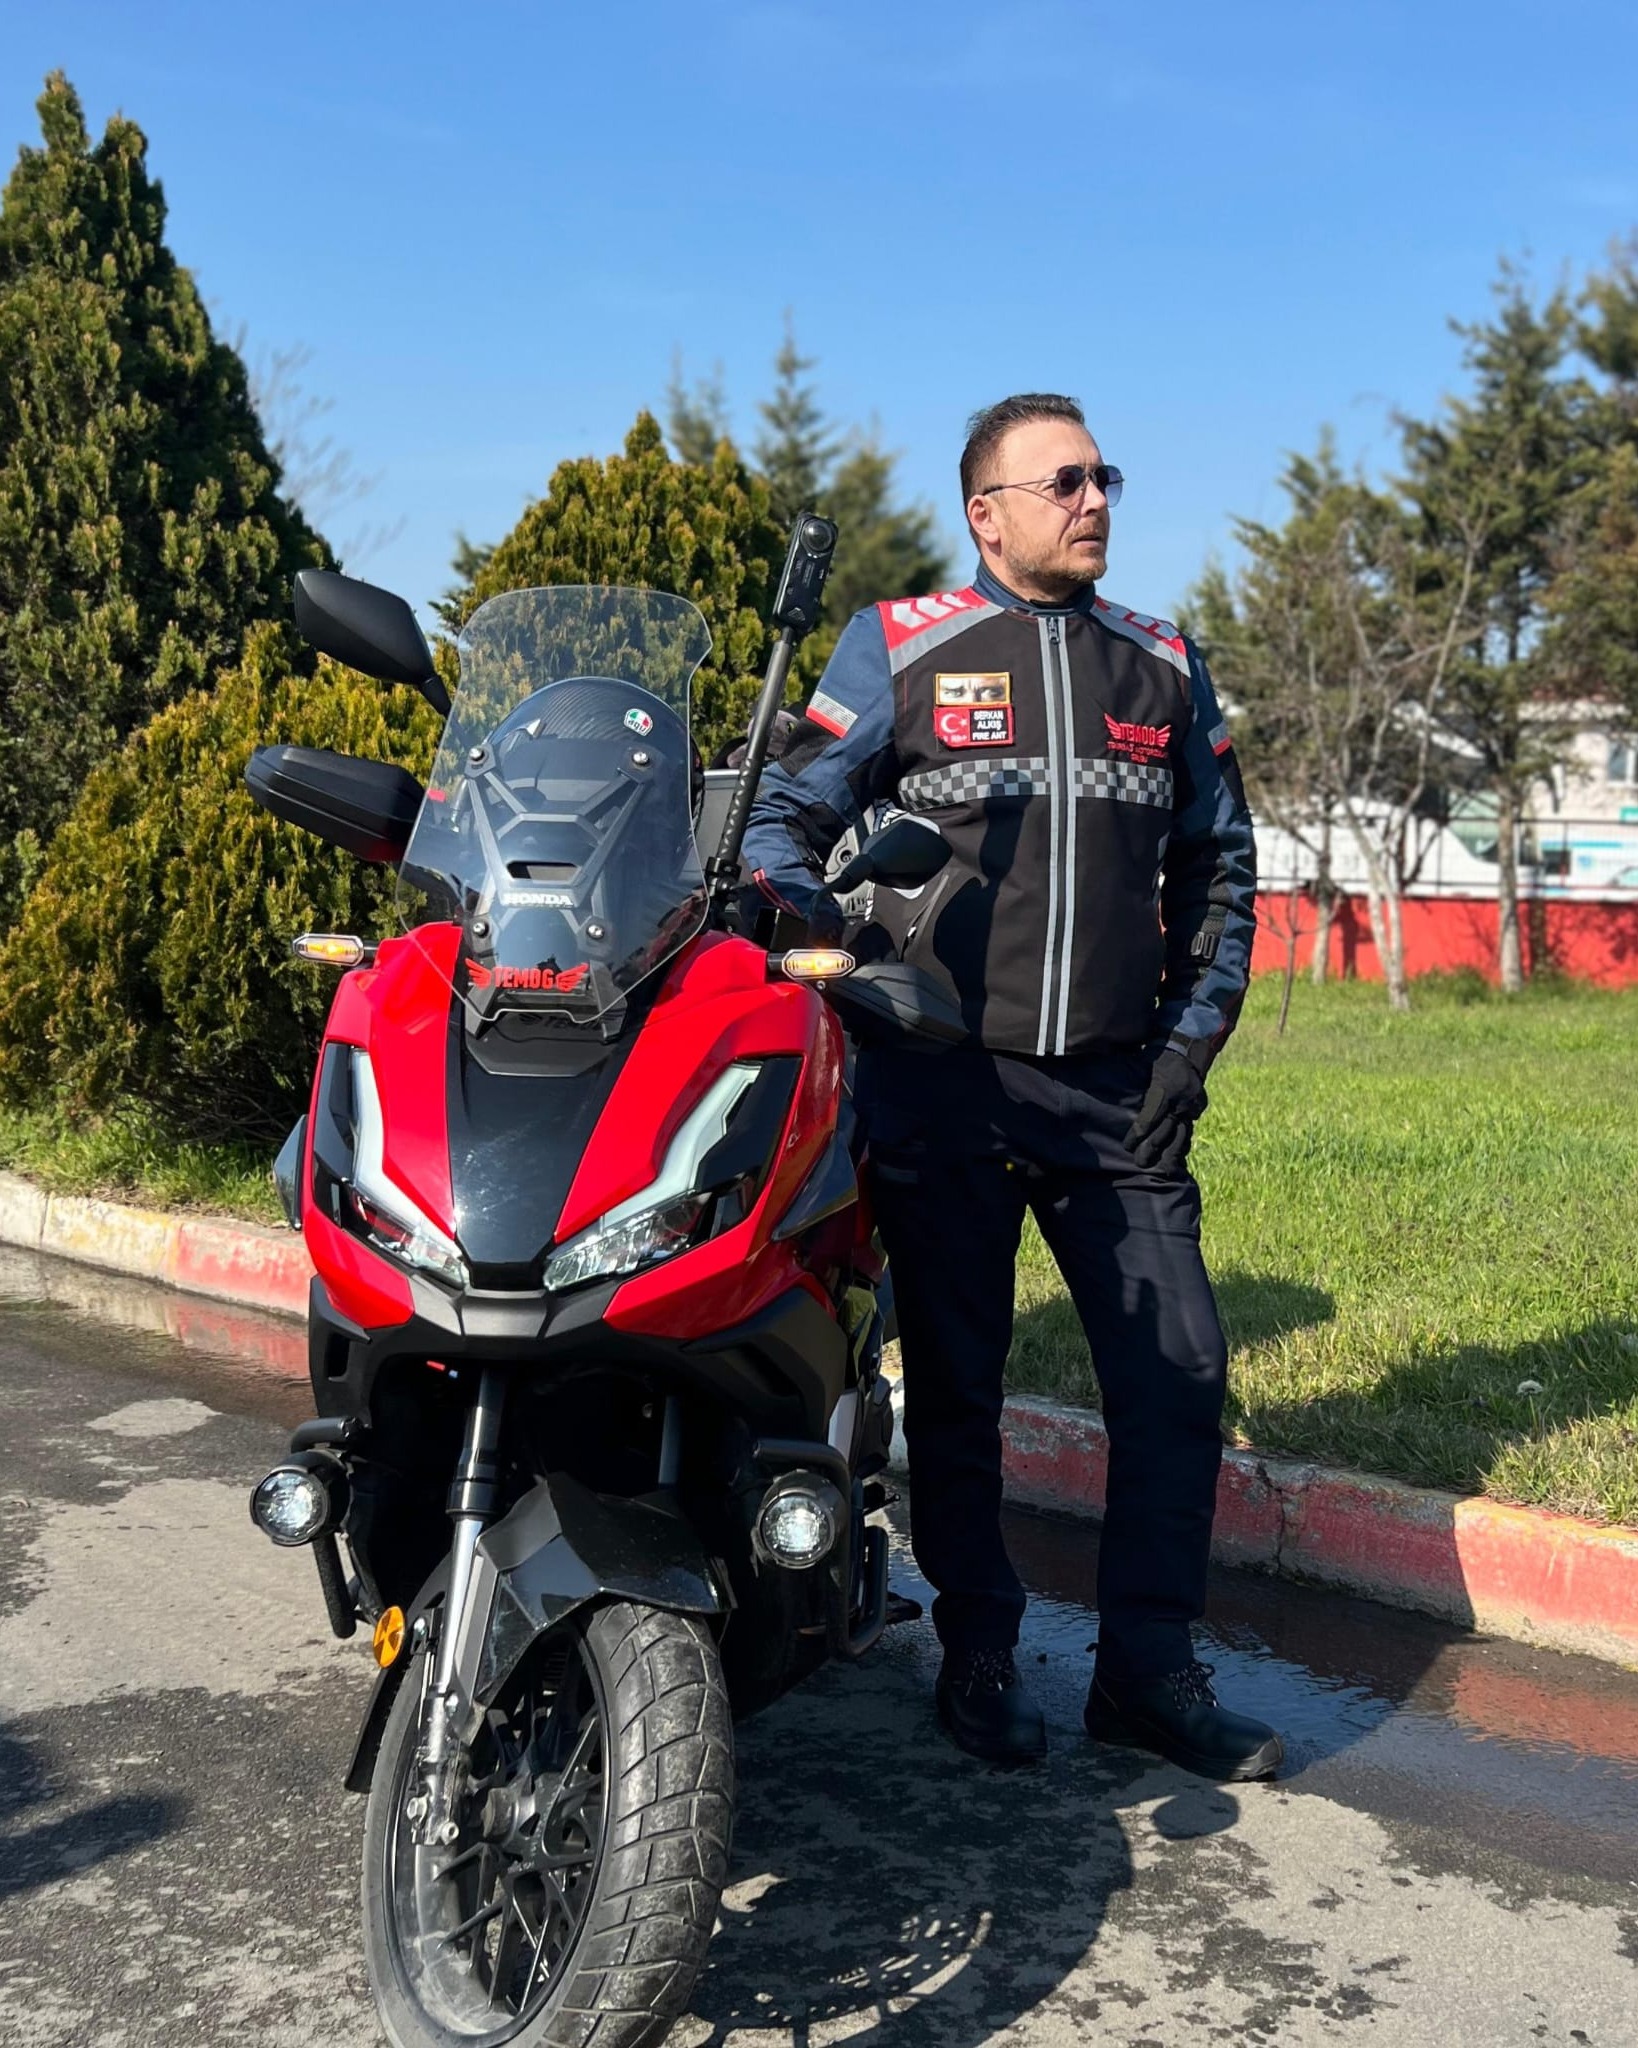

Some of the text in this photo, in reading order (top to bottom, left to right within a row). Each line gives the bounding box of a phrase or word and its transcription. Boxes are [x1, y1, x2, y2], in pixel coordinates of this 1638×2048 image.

[974, 710, 1004, 720] SERKAN
[972, 731, 989, 740] FIRE
[1120, 722, 1156, 745] TEMOG
[503, 892, 574, 906] HONDA
[494, 966, 554, 990] TEMOG
